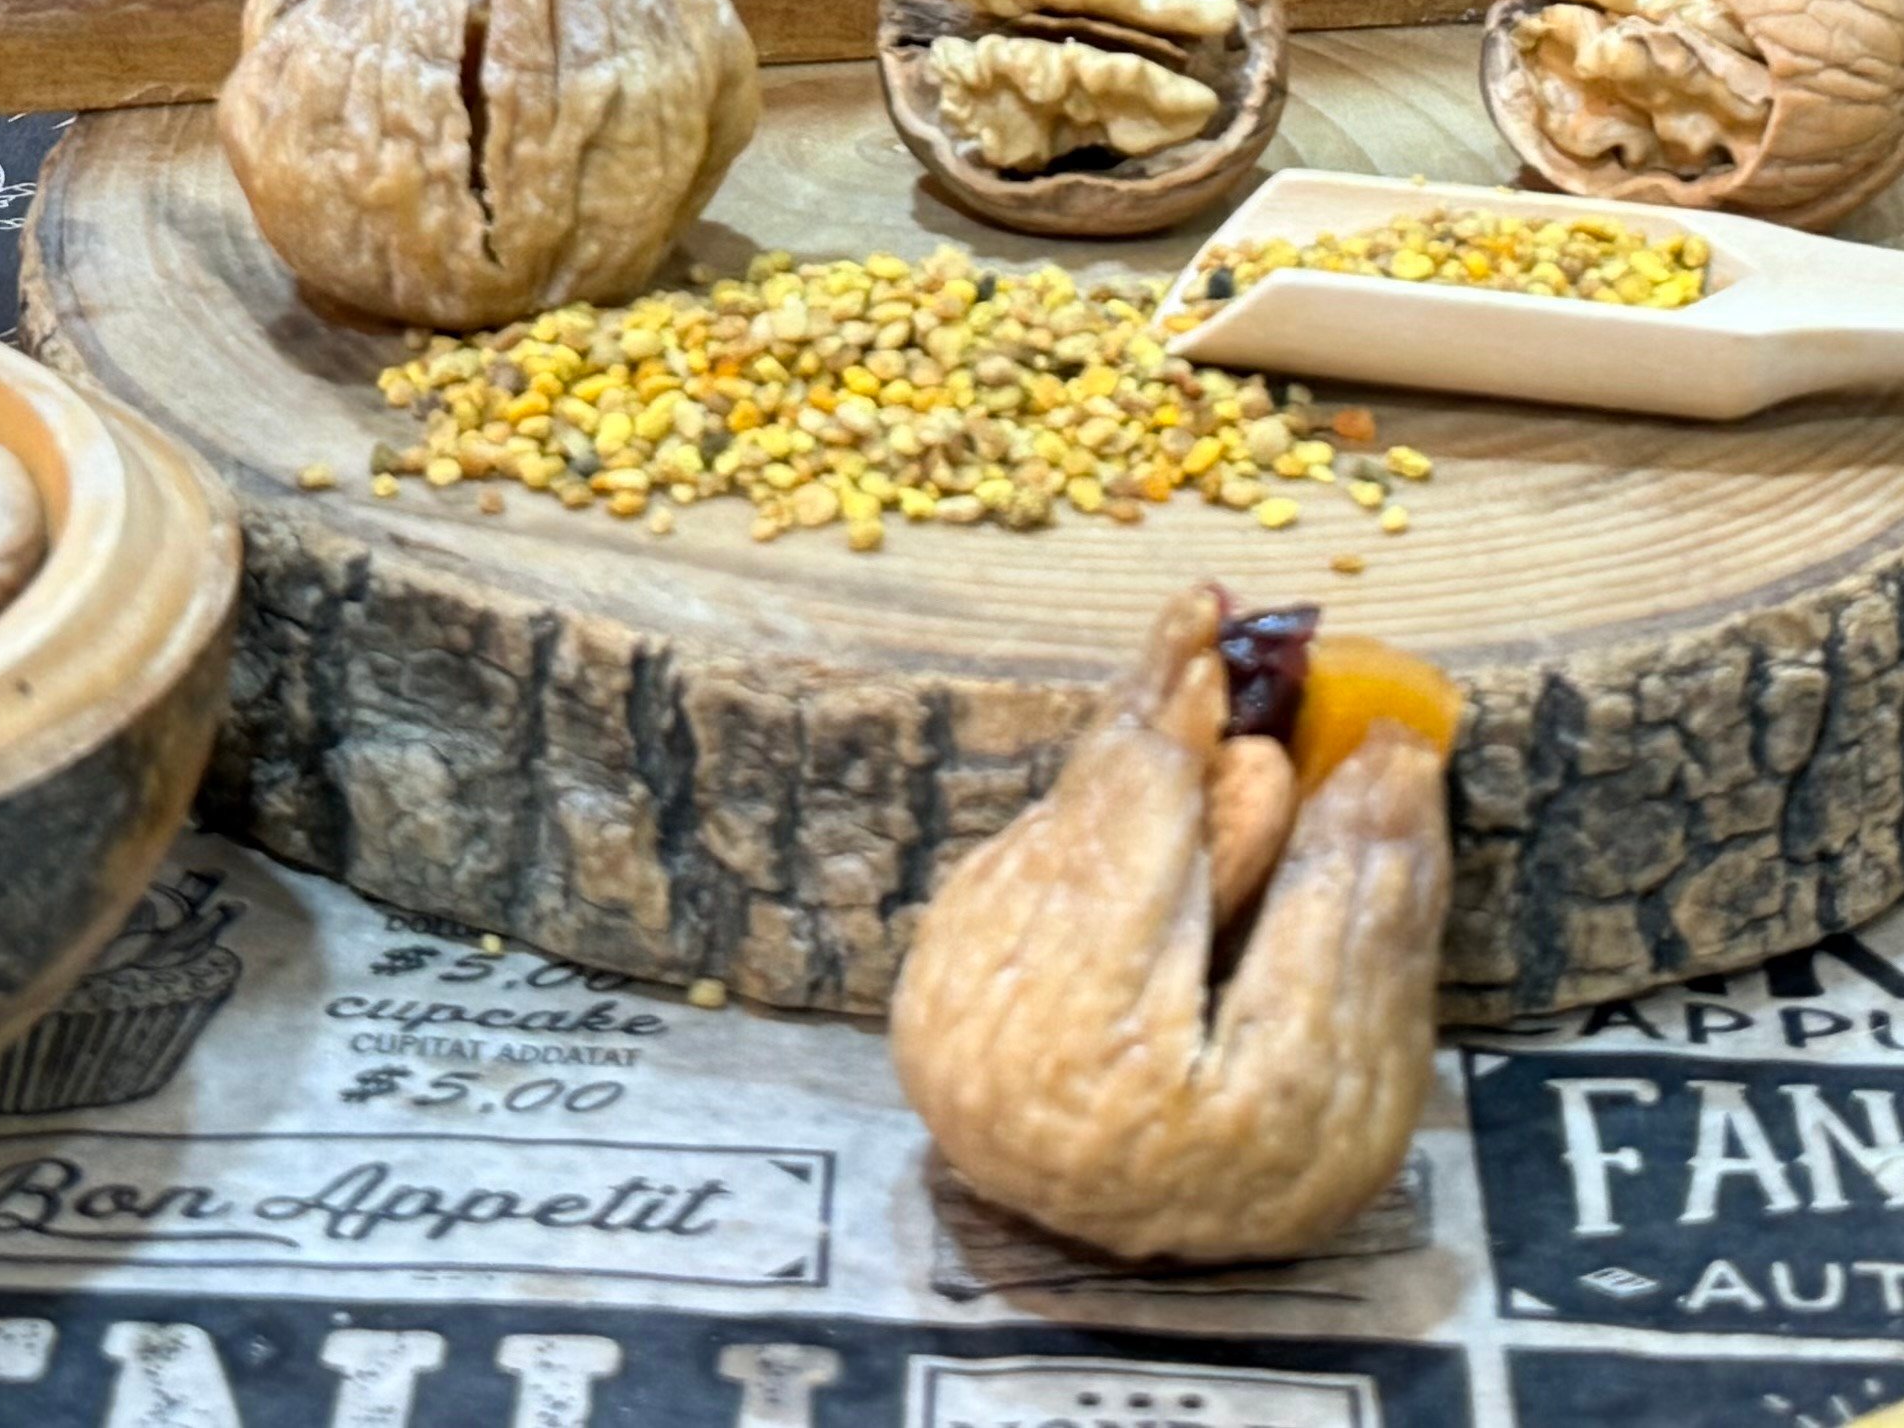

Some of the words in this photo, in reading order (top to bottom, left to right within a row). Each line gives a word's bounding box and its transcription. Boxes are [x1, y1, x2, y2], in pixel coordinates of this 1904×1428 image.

[324, 995, 669, 1036] cupcake
[350, 1032, 489, 1061] CUPITAT
[496, 1042, 644, 1069] ADDATAT
[339, 1064, 624, 1114] $5.00
[255, 1158, 732, 1241] Appetit
